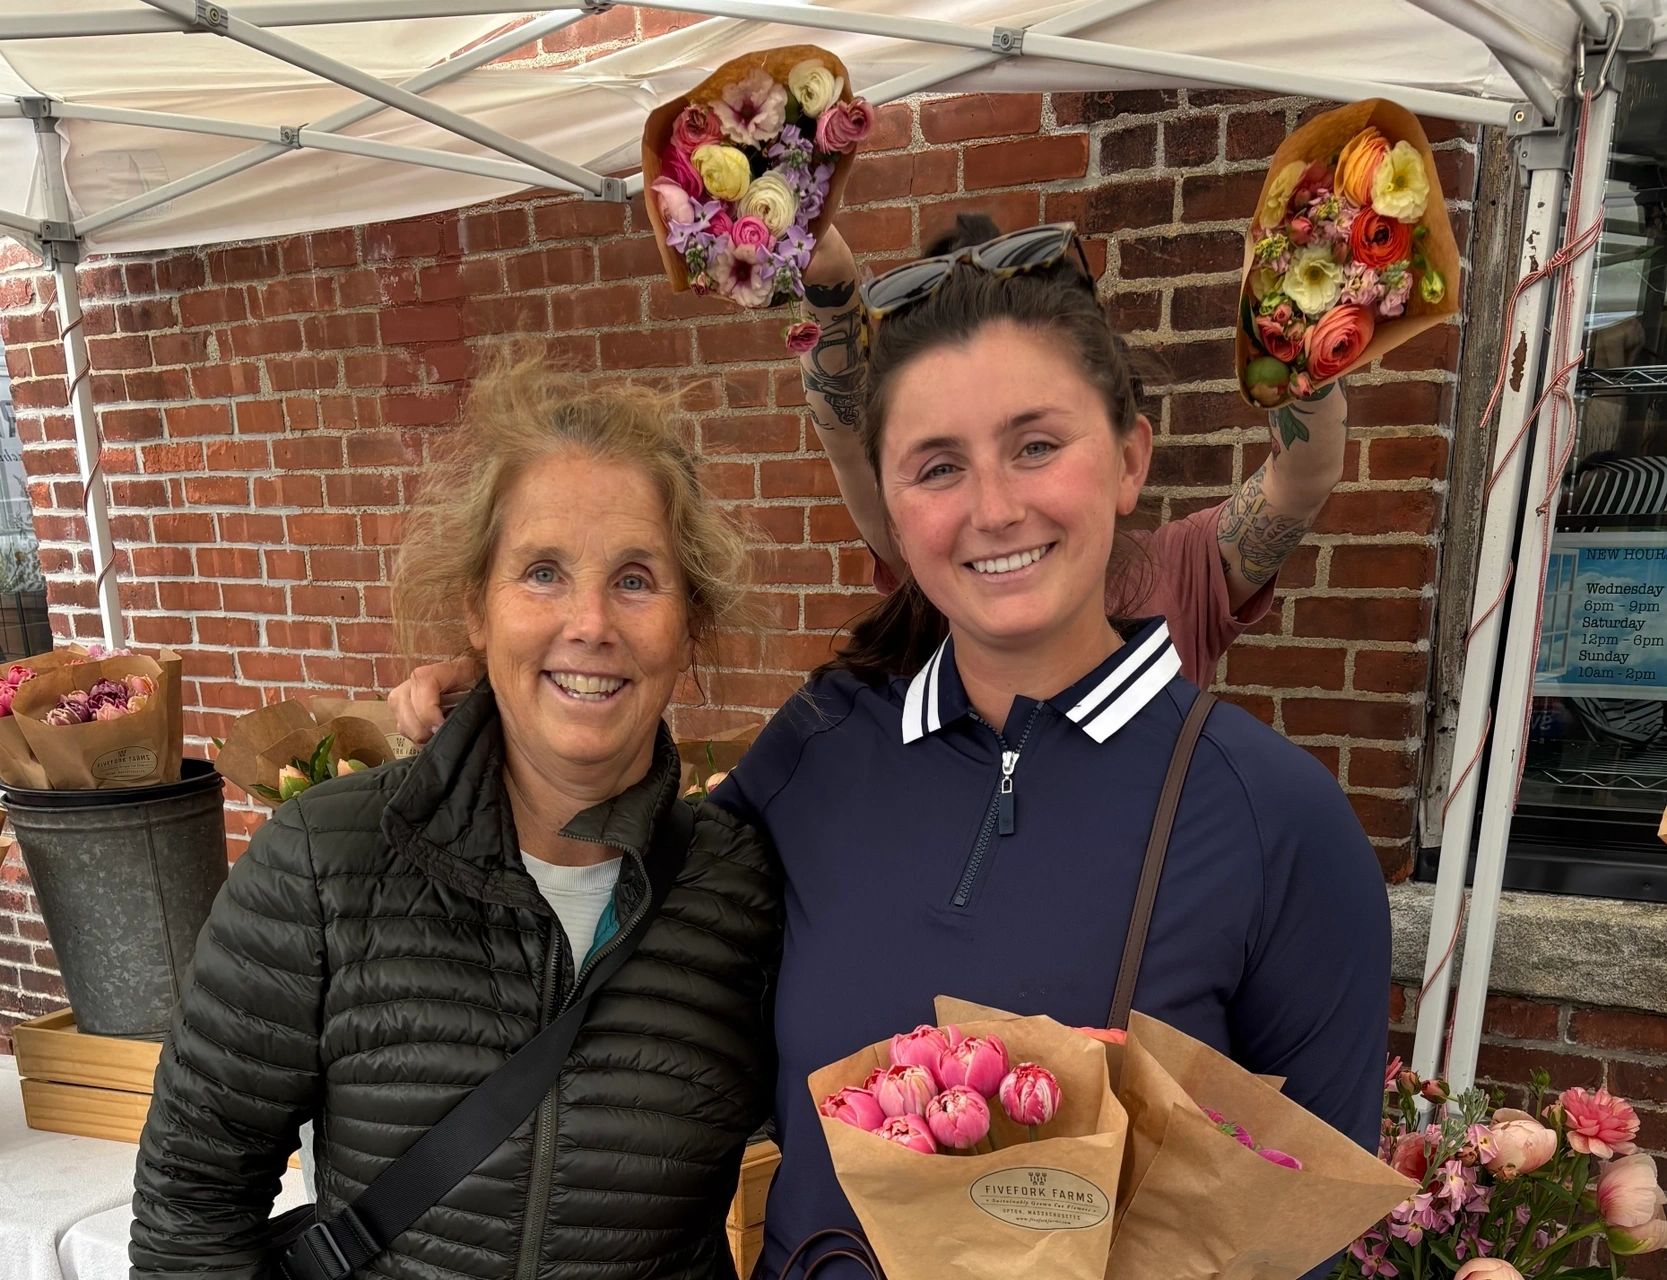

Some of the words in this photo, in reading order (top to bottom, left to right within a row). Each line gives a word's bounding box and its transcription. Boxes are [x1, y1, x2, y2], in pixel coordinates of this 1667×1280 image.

[1585, 548, 1619, 561] NEW
[1623, 548, 1667, 561] HOUR
[1586, 583, 1664, 597] Wednesday
[1583, 600, 1614, 614] 6pm
[1628, 600, 1660, 614] 9pm
[1582, 617, 1646, 631] Saturday
[1581, 633, 1619, 647] 12pm
[1633, 634, 1665, 648] 6pm
[1578, 650, 1630, 665] Sunday
[1578, 666, 1614, 679] 10am
[1625, 668, 1656, 682] 2pm
[985, 1185, 1046, 1197] FIVEFORK
[1052, 1188, 1093, 1204] FARMS
